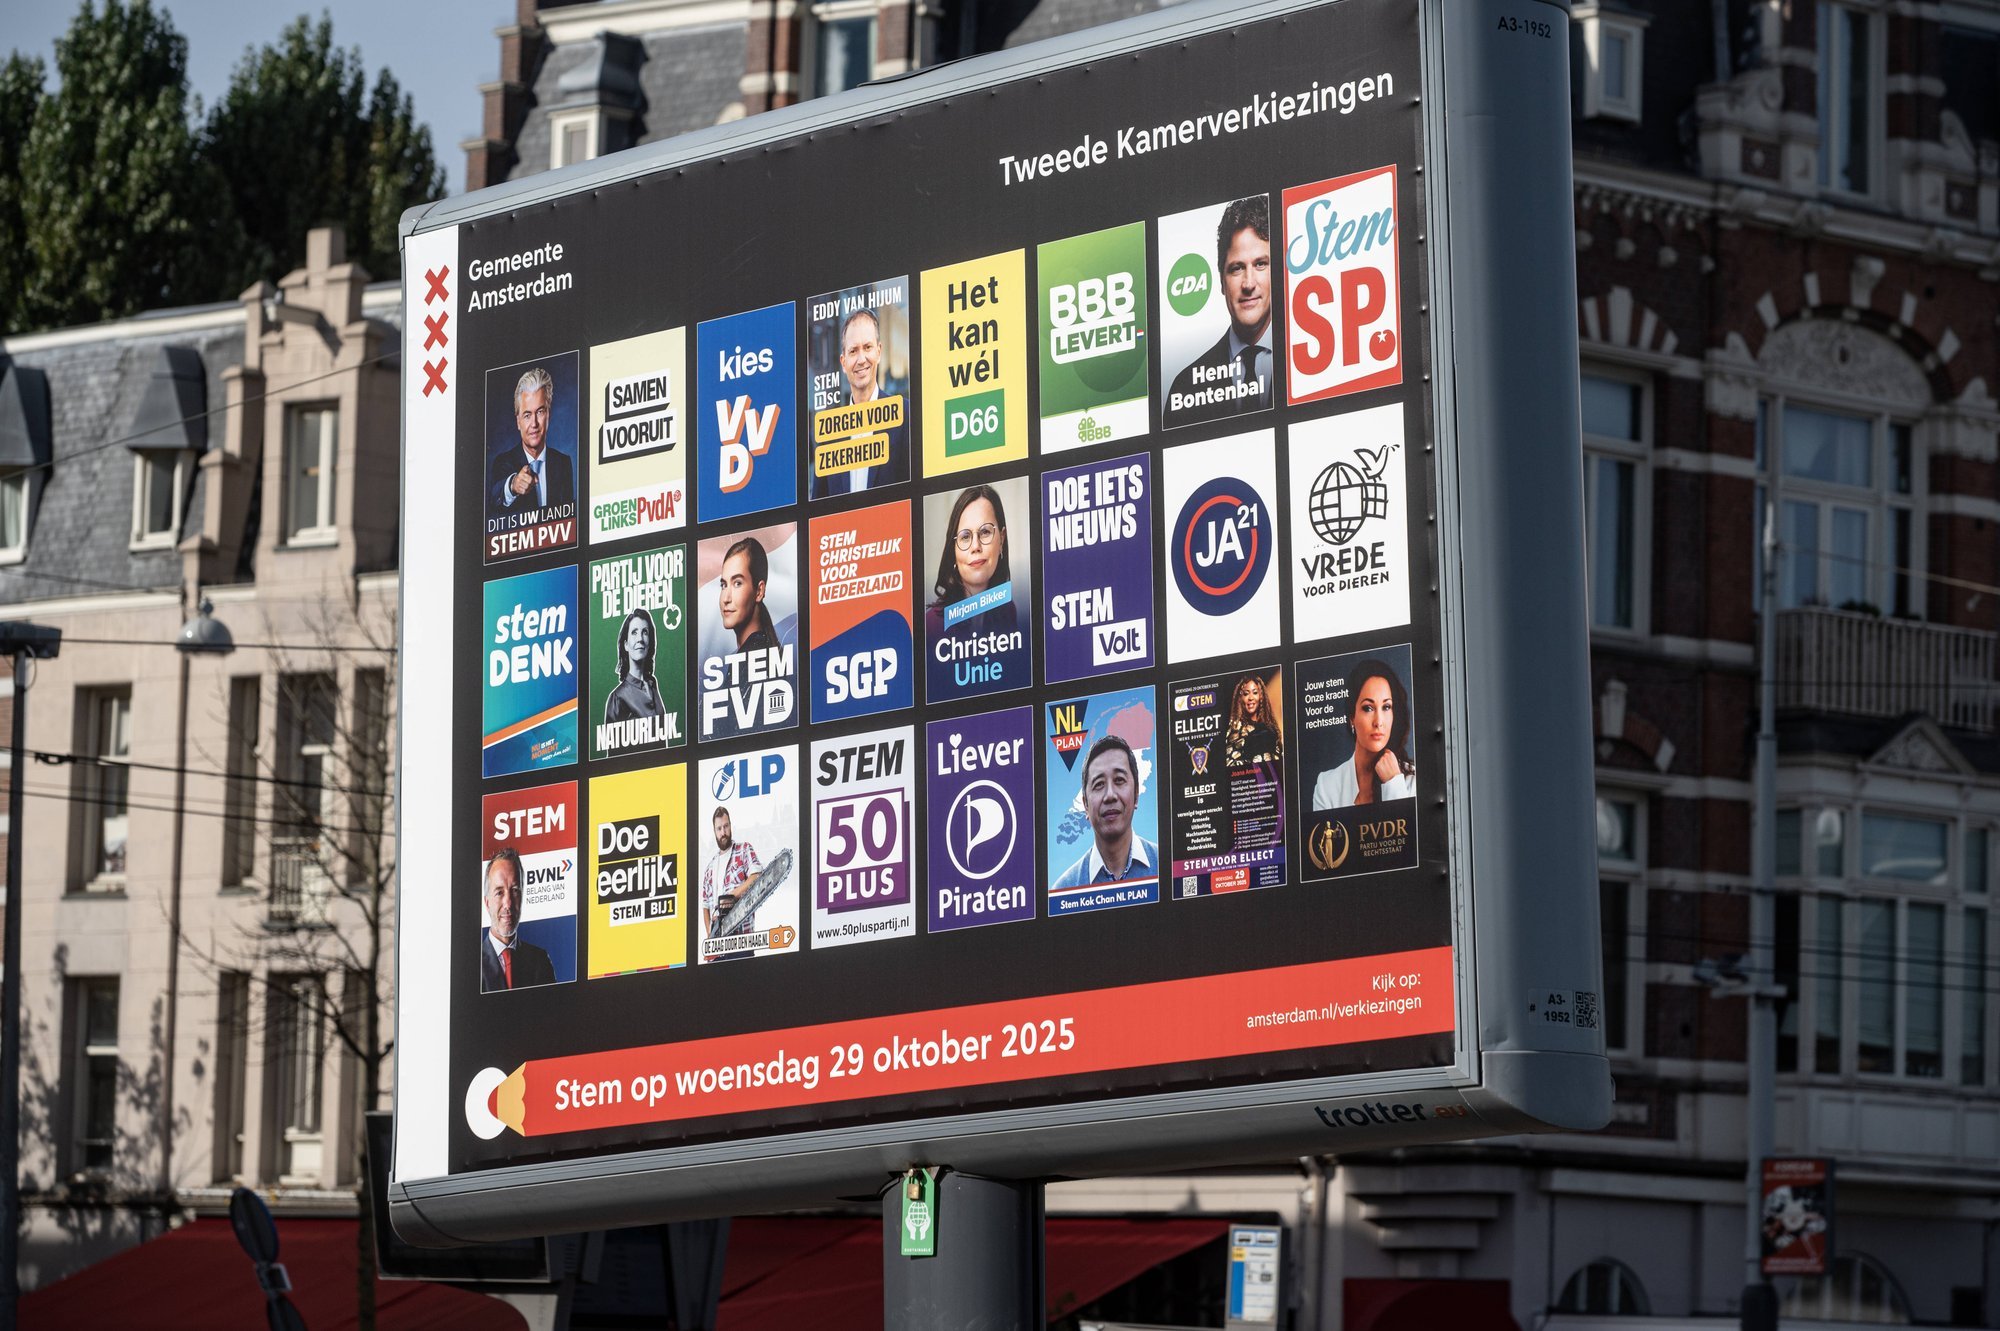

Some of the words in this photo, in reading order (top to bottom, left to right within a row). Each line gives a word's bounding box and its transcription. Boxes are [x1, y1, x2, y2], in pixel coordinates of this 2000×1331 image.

[1498, 16, 1551, 38] A3-1952
[999, 134, 1107, 186] Tweede
[1117, 72, 1393, 159] Kamerverkiezingen
[1285, 199, 1396, 275] Stem
[468, 242, 563, 281] Gemeente
[467, 272, 573, 312] Amsterdam
[948, 276, 999, 314] Het
[1050, 271, 1135, 329] BBB
[1170, 272, 1208, 297] CDA
[813, 299, 841, 322] EDDY
[843, 294, 865, 313] VAN
[868, 286, 902, 310] HIJUM
[948, 317, 999, 351] kan
[1055, 320, 1136, 357] LEVERT
[719, 345, 773, 382] kies
[948, 349, 999, 388] wél
[1192, 355, 1242, 385] Henri
[612, 376, 667, 409] SAMEN
[814, 371, 840, 392] STEM
[1170, 375, 1265, 412] Bontenbal
[606, 416, 673, 450] VOORUIT
[818, 410, 863, 436] ZORGEN
[866, 403, 899, 427] VOOR
[950, 404, 999, 441] D66
[1087, 425, 1112, 442] BBB
[818, 440, 885, 471] ZEKERHEID!
[1049, 474, 1090, 515] DOE
[1094, 464, 1144, 507] IETS
[488, 516, 506, 533] DIT
[508, 514, 517, 529] IS
[519, 511, 539, 526] UW
[541, 502, 574, 522] LAND!
[593, 498, 637, 519] GROEN
[600, 512, 637, 532] LINKS
[637, 490, 675, 525] PvdA
[490, 529, 534, 556] STEM
[538, 521, 572, 547] PVV
[819, 529, 857, 551] STEM
[1049, 502, 1137, 552] NIEUWS
[819, 537, 903, 567] CHRISTELIJK
[1301, 541, 1386, 582] VREDE
[591, 556, 643, 594] PARTIJ
[644, 549, 684, 583] VOOR
[820, 563, 858, 583] VOOR
[820, 573, 901, 602] NEDERLAND
[1302, 580, 1335, 598] VOOR
[1339, 571, 1389, 592] DIEREN
[602, 588, 621, 620] DE
[625, 578, 673, 615] DIEREN
[948, 600, 978, 621] Mirjam
[980, 589, 1007, 608] Bikker
[1051, 586, 1114, 631] STEM
[494, 603, 567, 644] stem
[935, 630, 1022, 663] Christen
[1098, 627, 1141, 657] Volt
[489, 636, 573, 687] DENK
[703, 643, 794, 690] STEM
[825, 647, 898, 704] SGP
[954, 657, 1003, 687] Unie
[1190, 694, 1213, 707] STEM
[1304, 681, 1325, 692] Jouw
[1325, 677, 1344, 688] stem
[1305, 694, 1325, 704] Onze
[1325, 688, 1349, 701] kracht
[703, 679, 794, 736] FVD
[1055, 704, 1082, 735] NL
[1305, 706, 1323, 717] Voor
[1323, 704, 1334, 714] de
[1305, 715, 1347, 729] rechtsstaat
[596, 711, 682, 752] NATUURLIJK.
[1175, 714, 1221, 736] ELLECT
[937, 733, 1024, 776] Liever
[1056, 735, 1083, 751] PLAN
[739, 753, 786, 799] LP
[816, 739, 905, 787] STEM
[1184, 783, 1216, 796] ELLECT
[1197, 797, 1204, 805] is
[493, 802, 565, 841] STEM
[826, 797, 897, 868] 50
[1358, 818, 1409, 842] PVDR
[598, 822, 649, 856] Doe
[1359, 842, 1378, 850] PARTIJ
[1379, 840, 1396, 848] VOOR
[1397, 838, 1406, 846] DE
[1363, 847, 1403, 857] RECHTSSTAAT
[526, 866, 565, 886] BVNL
[597, 855, 678, 897] eerlijk.
[1183, 858, 1208, 871] STEM
[1211, 854, 1237, 867] VOOR
[1240, 849, 1275, 863] ELLECT
[1235, 869, 1245, 880] 29
[526, 885, 551, 896] BELANG
[552, 883, 565, 892] VAN
[526, 892, 565, 905] NEDERLAND
[828, 867, 895, 903] PLUS
[938, 884, 1026, 919] Piraten
[1060, 900, 1079, 910] Stem
[1080, 897, 1095, 908] Kok
[1095, 894, 1115, 905] Chan
[1116, 893, 1126, 903] NL
[1127, 889, 1148, 901] PLAN
[612, 904, 642, 921] STEM
[650, 899, 674, 916] BIJ1
[816, 916, 910, 939] www.50pluspartij.nl
[1372, 973, 1396, 991] Kijk
[1399, 972, 1421, 990] op:
[1246, 995, 1422, 1028] amsterdam.nl/verkiezingen
[1547, 994, 1566, 1005] A3-
[1543, 1011, 1570, 1023] 1952
[555, 1078, 622, 1111] Stem
[631, 1074, 667, 1107] op
[675, 1050, 820, 1090] woensdag
[830, 1043, 864, 1079] 29
[873, 1031, 992, 1074] oktober
[1002, 1017, 1075, 1059] 2025
